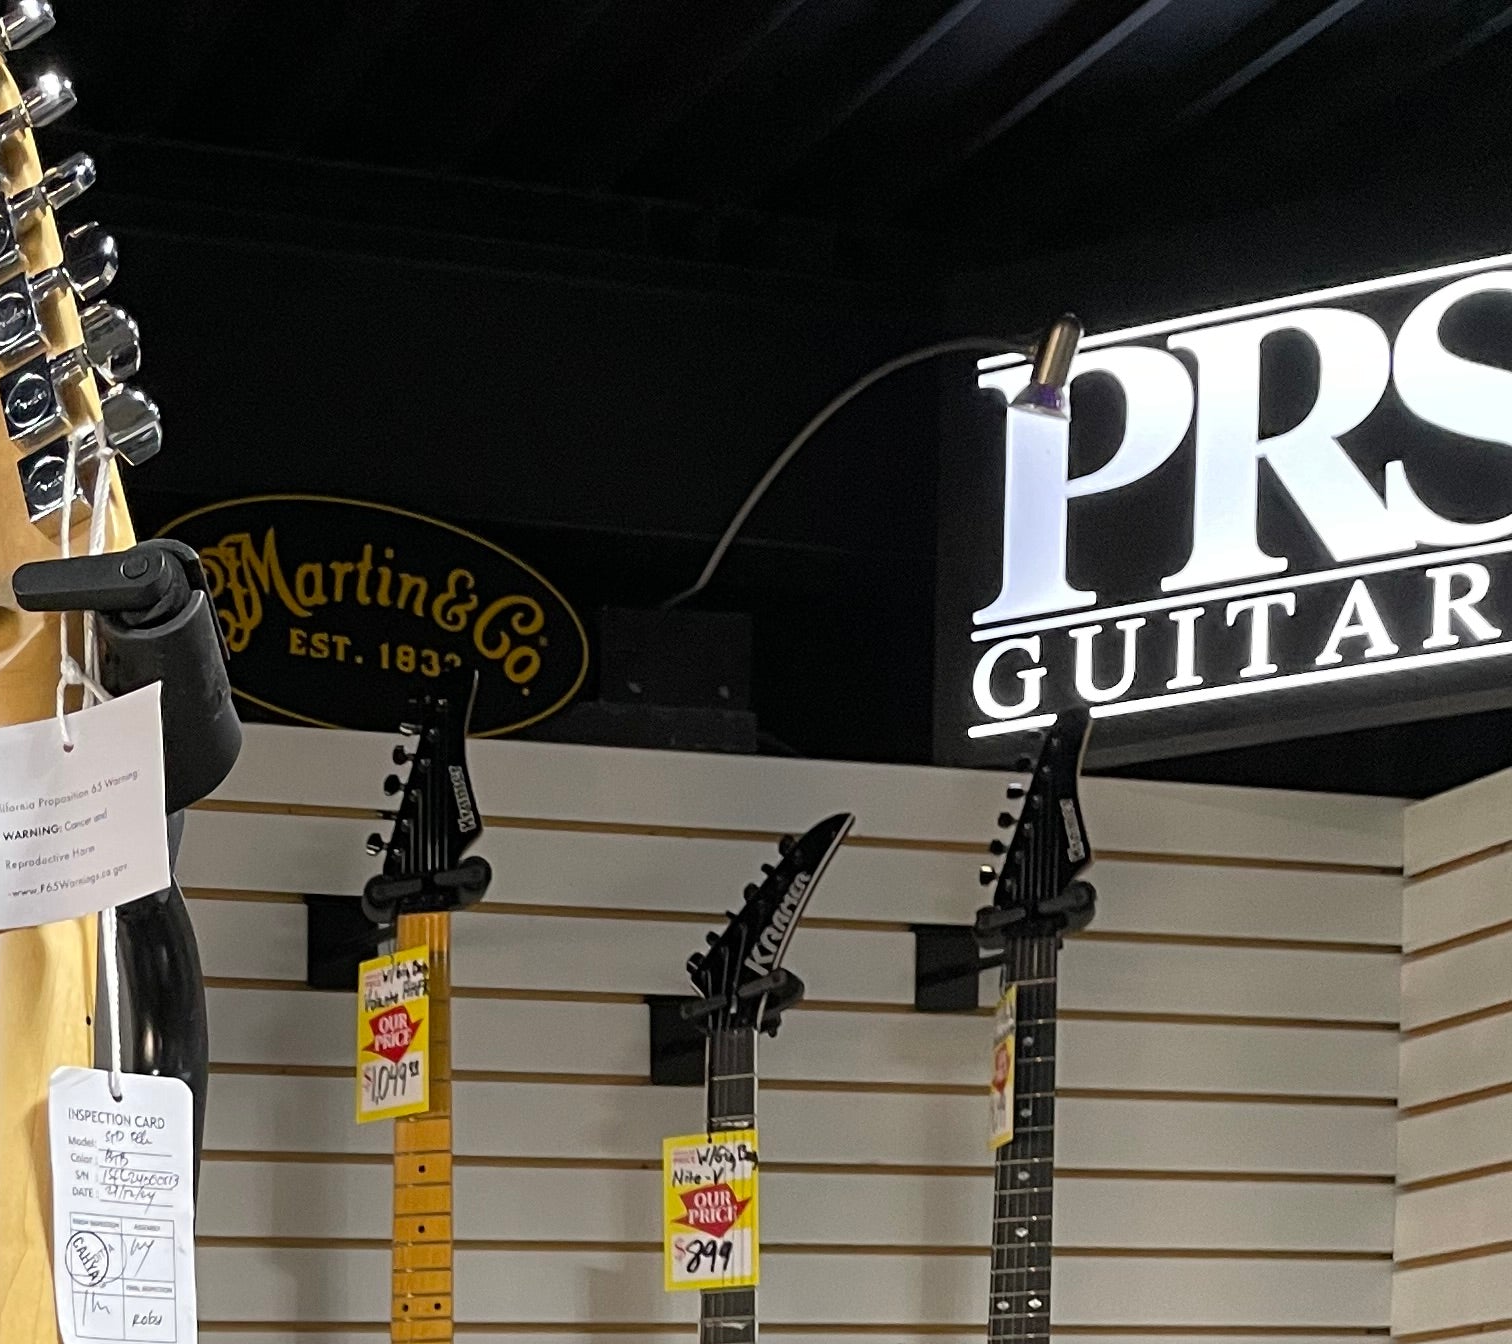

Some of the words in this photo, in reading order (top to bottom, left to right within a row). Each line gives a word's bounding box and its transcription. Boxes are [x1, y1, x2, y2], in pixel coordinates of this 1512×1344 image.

[972, 269, 1512, 625] PRS
[432, 568, 479, 632] &
[290, 627, 364, 664] EST.
[38, 788, 90, 810] Proposition
[90, 781, 104, 795] 65
[3, 823, 63, 842] WARNING:
[64, 815, 92, 832] Cancer
[93, 807, 109, 824] and
[5, 850, 70, 872] Reproductive
[72, 844, 96, 859] Harm
[377, 1012, 408, 1034] OUR
[375, 1026, 412, 1052] PRICE
[68, 1107, 131, 1127] INSPECTION
[134, 1115, 166, 1130] CARD
[693, 1190, 731, 1208] OUR
[687, 1205, 738, 1225] PRICE
[674, 1237, 733, 1274] $899
